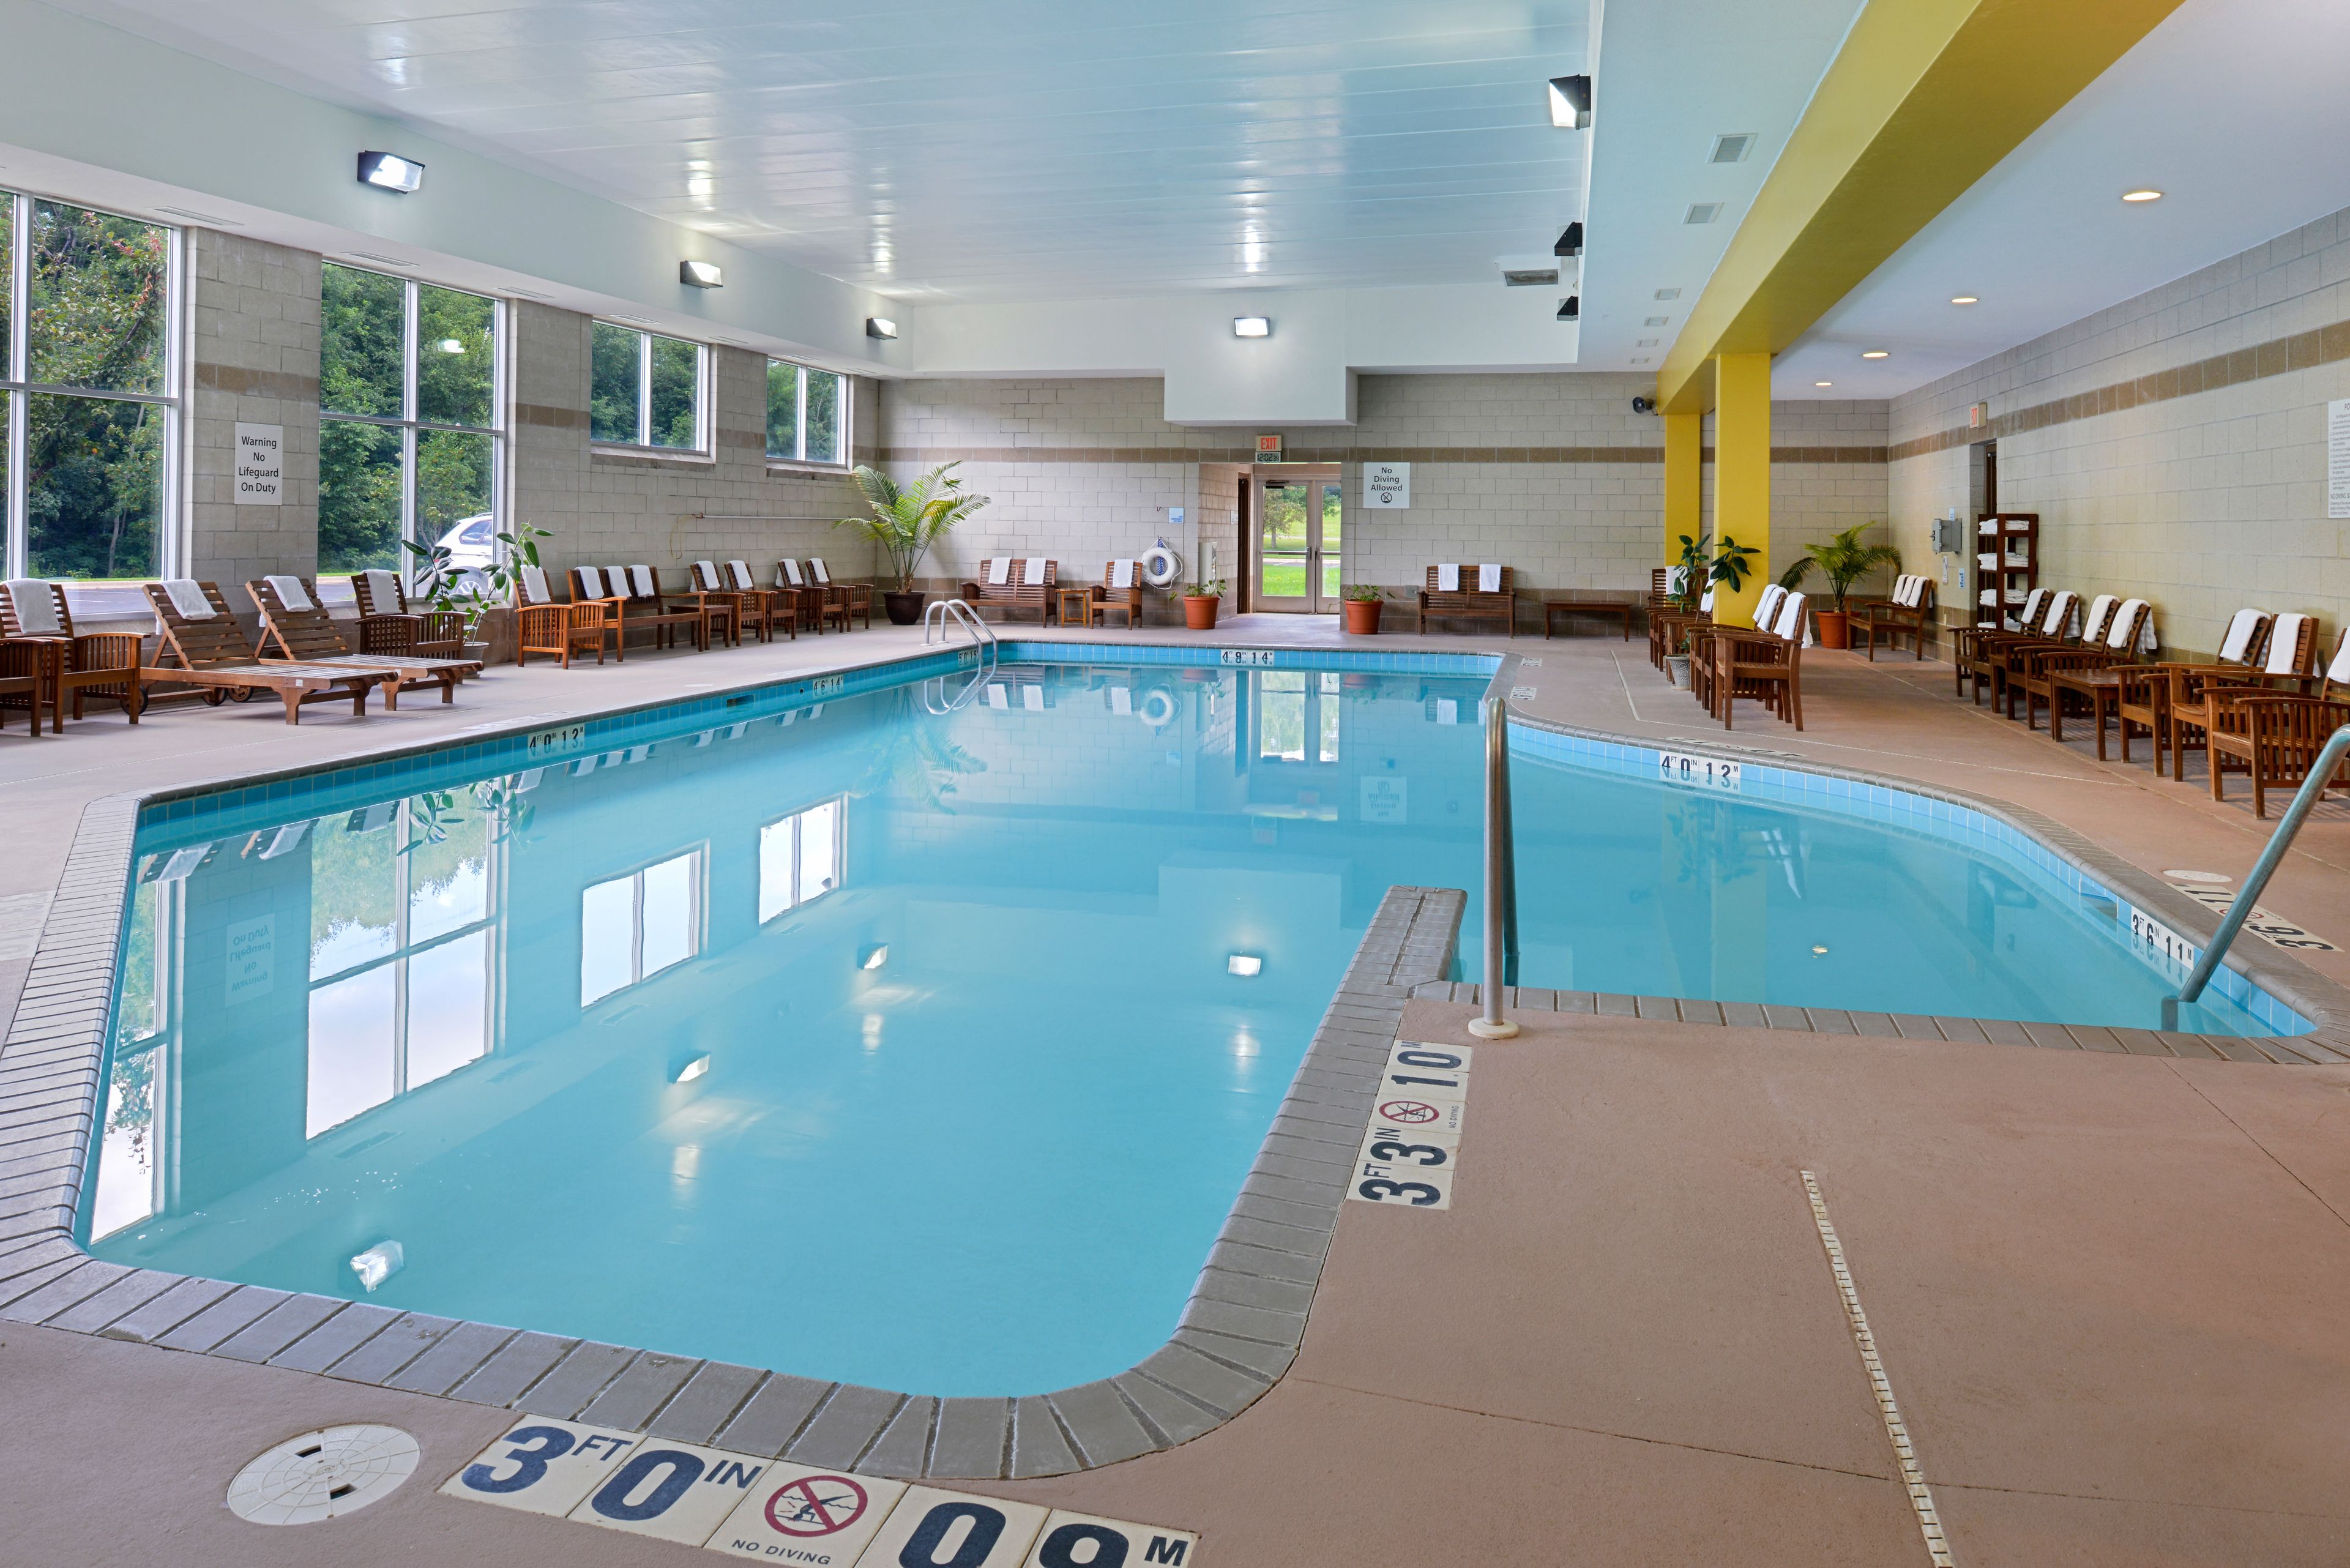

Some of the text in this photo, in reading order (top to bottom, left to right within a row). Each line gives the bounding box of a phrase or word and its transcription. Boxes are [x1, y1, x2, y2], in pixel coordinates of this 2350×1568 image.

[241, 436, 277, 449] Warning
[1261, 437, 1277, 450] EXIT
[253, 452, 265, 461] No
[239, 466, 278, 479] Lifeguard
[1374, 476, 1399, 484] Diving
[241, 482, 276, 495] On Duty
[1450, 1105, 1459, 1121] DIVING
[731, 1539, 832, 1566] NO DIVING
